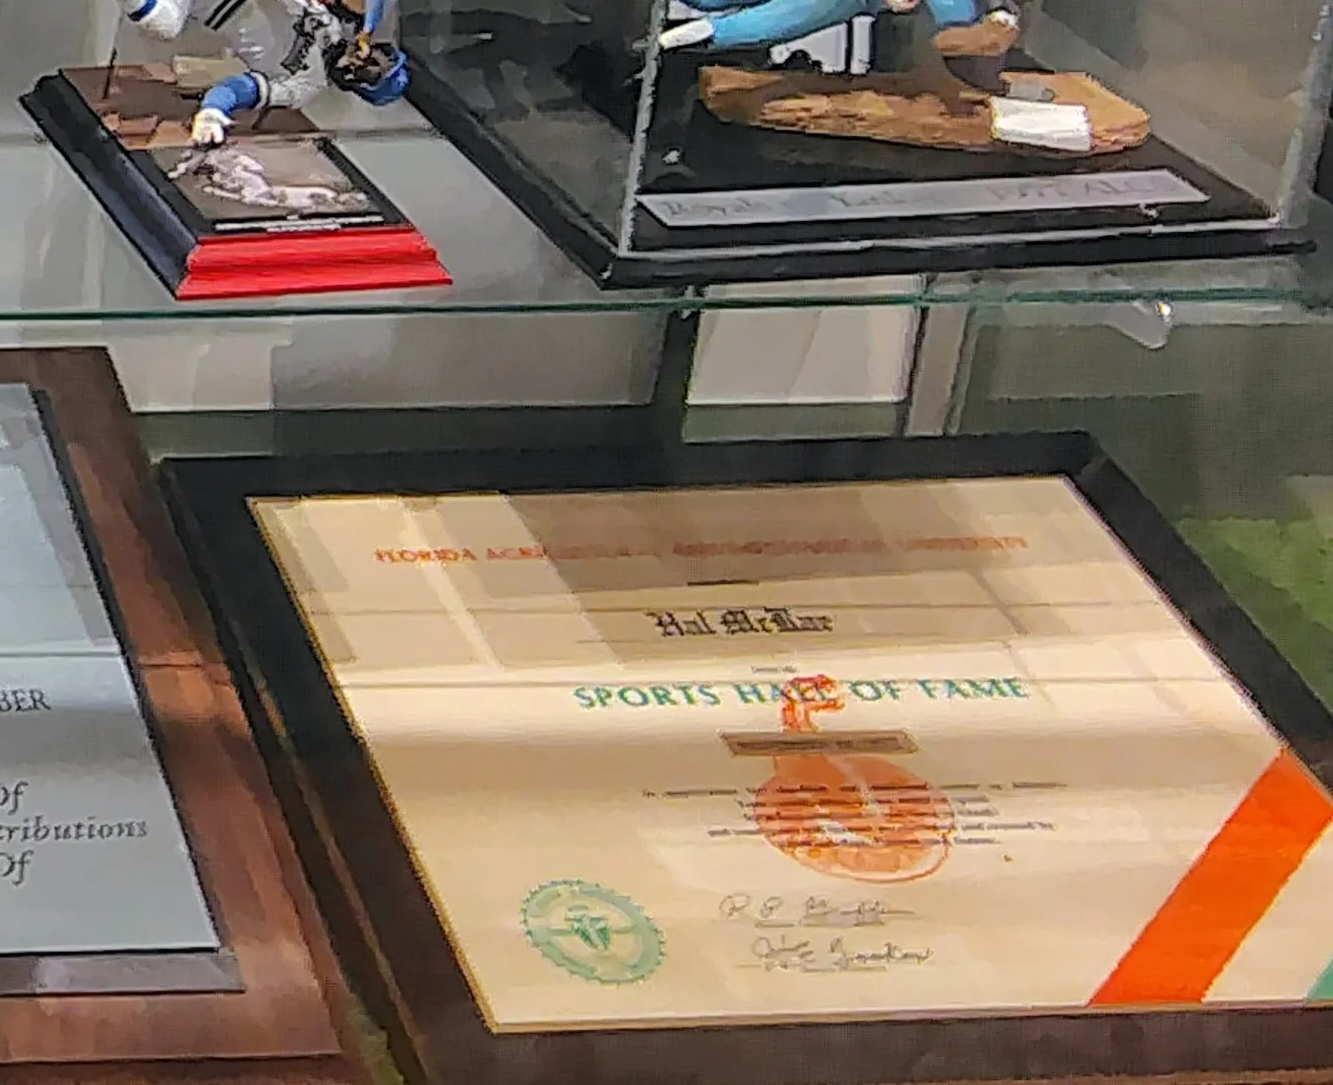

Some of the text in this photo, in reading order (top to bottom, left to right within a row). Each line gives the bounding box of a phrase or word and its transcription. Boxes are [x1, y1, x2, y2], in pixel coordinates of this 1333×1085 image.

[373, 547, 478, 563] FLORIDA
[572, 675, 1030, 710] SPORTS HALL OF FAME
